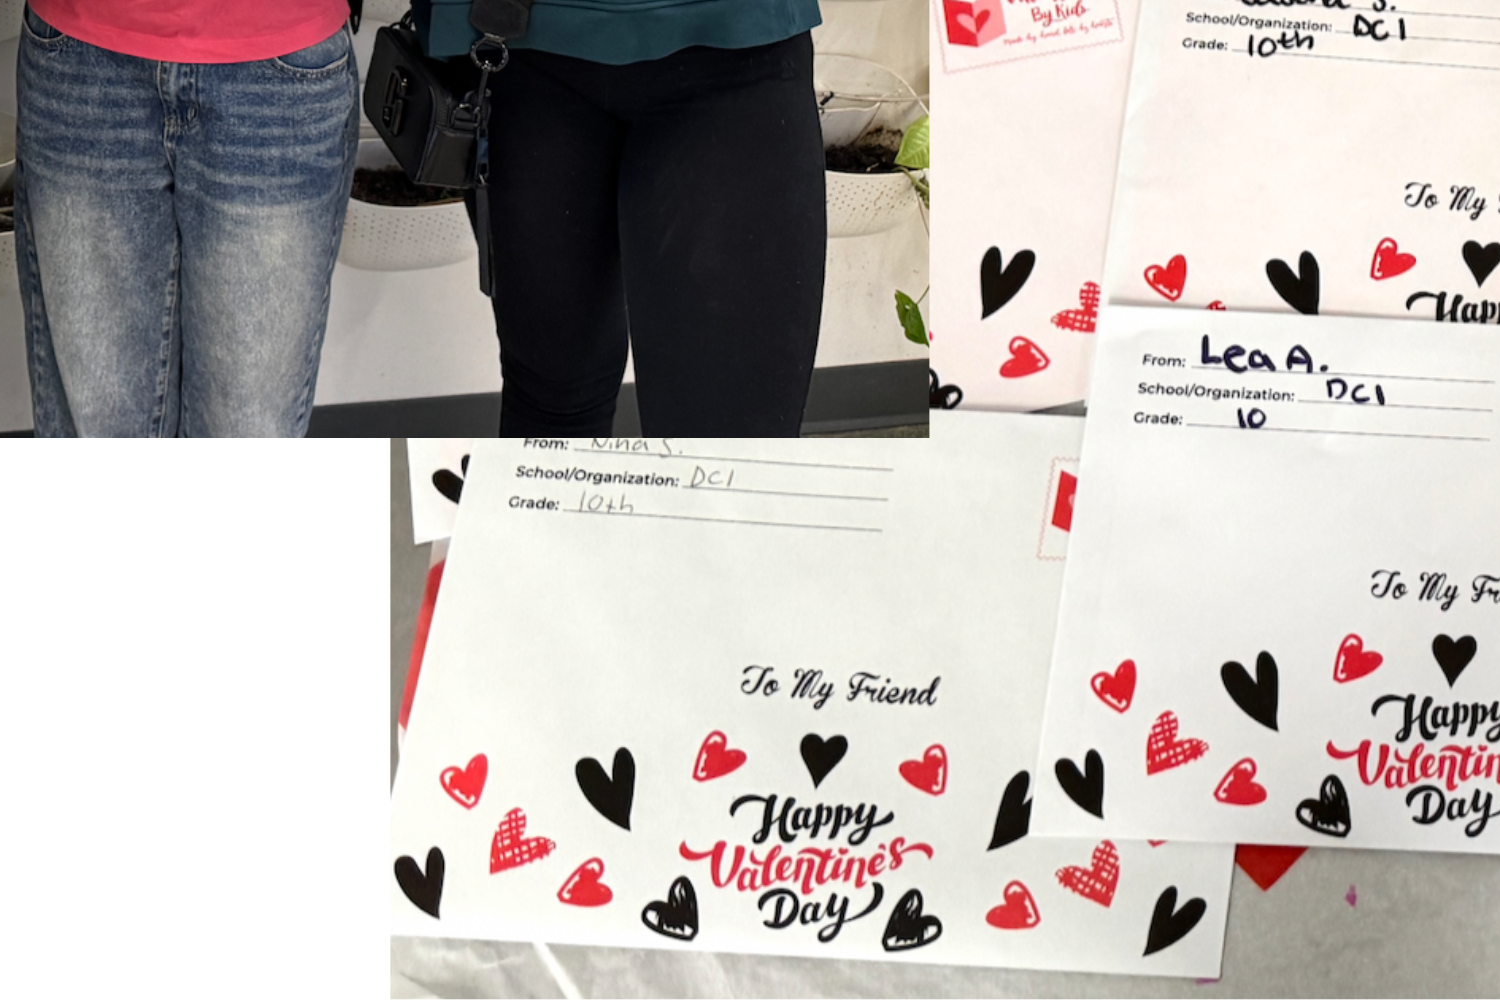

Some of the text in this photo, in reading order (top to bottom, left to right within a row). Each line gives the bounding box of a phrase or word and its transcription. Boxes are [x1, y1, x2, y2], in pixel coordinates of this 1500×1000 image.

[1030, 5, 1053, 28] By
[1186, 11, 1333, 34] School/Organization:
[1182, 31, 1314, 58] Grade: 10th
[1404, 182, 1438, 211] To
[1448, 184, 1487, 220] My
[1142, 335, 1330, 375] From: Lea A.
[1137, 381, 1296, 404] School/Organization:
[1133, 408, 1267, 429] Grade: 10
[515, 464, 680, 488] School/Organization:
[508, 490, 635, 515] Grade: 10th
[1370, 569, 1407, 599] To
[1417, 570, 1460, 611] My
[740, 665, 942, 710] To My Friend
[730, 793, 895, 846] Happy
[678, 837, 934, 894] Valentine's
[757, 881, 884, 943] Day
